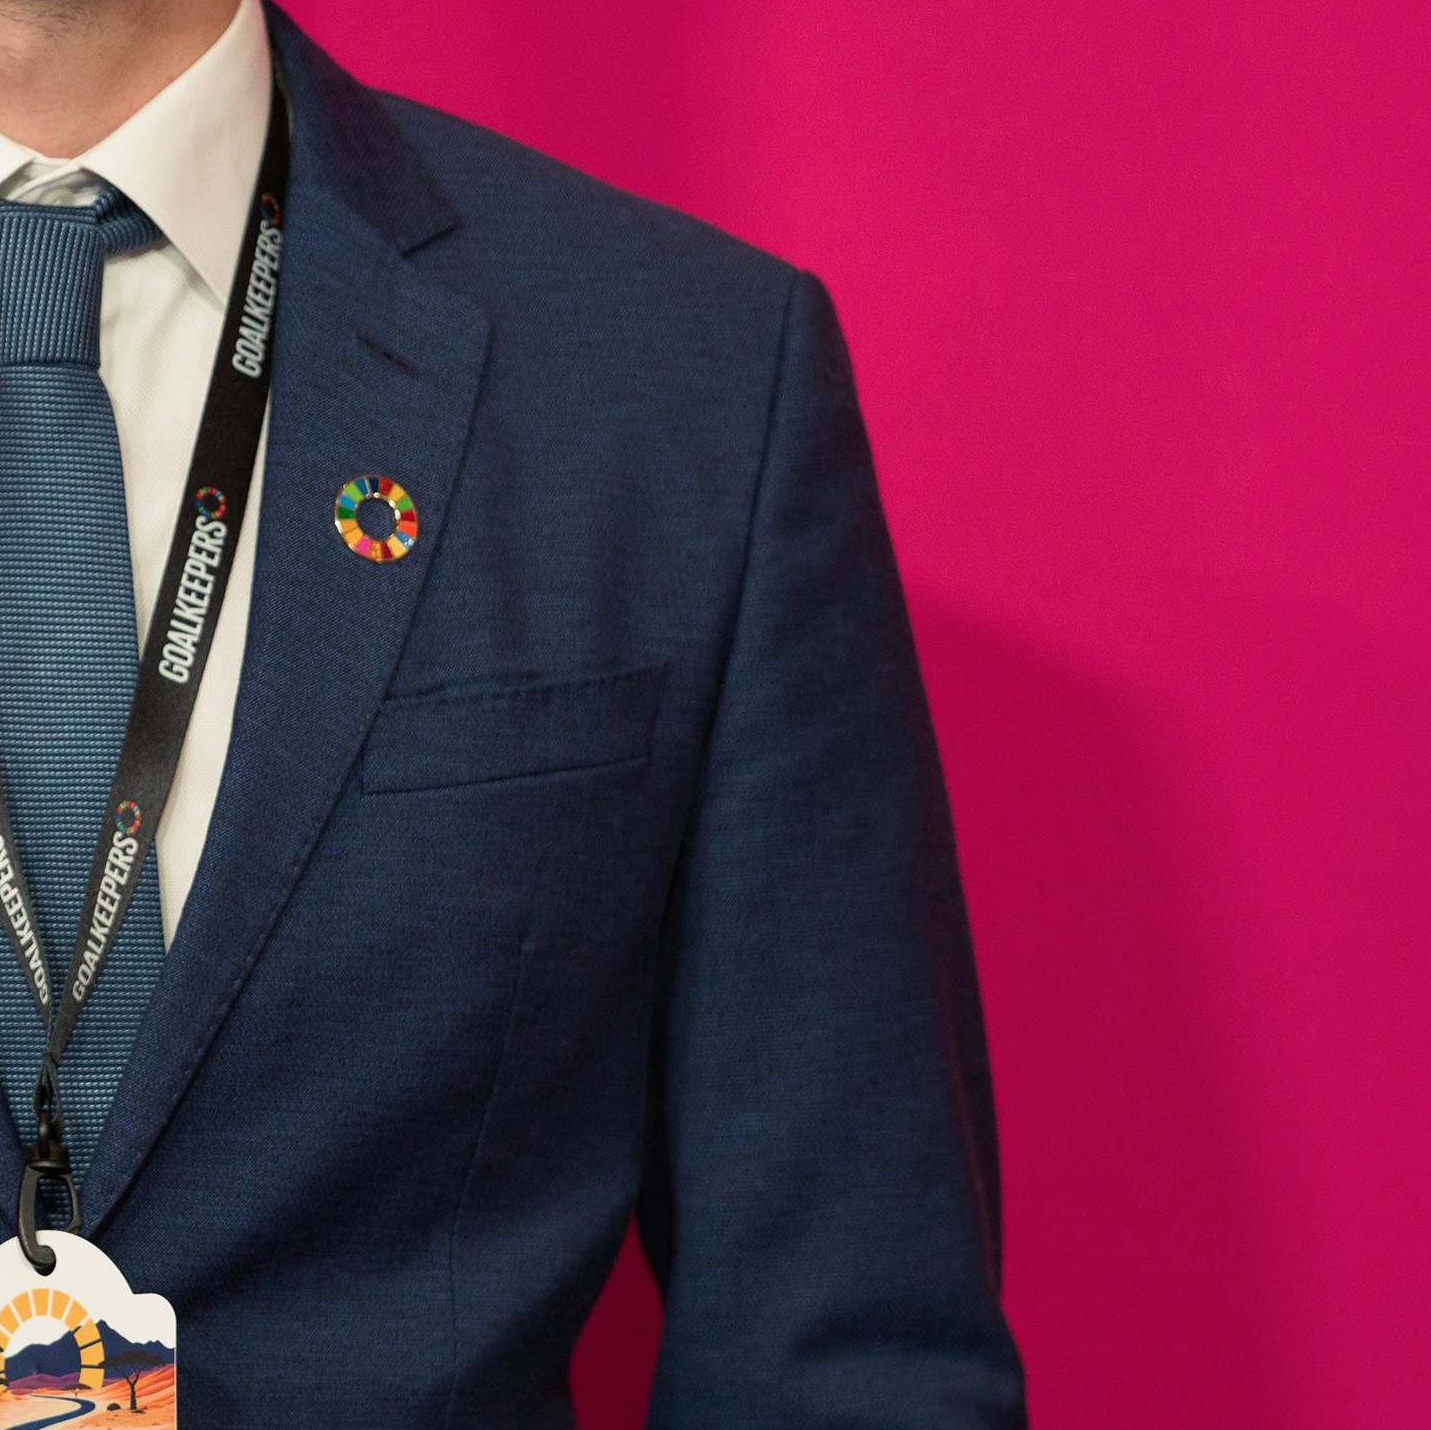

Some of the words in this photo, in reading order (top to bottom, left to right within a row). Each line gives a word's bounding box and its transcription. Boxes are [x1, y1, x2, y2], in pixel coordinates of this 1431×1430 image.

[232, 220, 284, 379] GOALKEEPERS
[158, 515, 228, 685] GOALKEEPERS
[72, 830, 139, 1002] GOALKEEPERS
